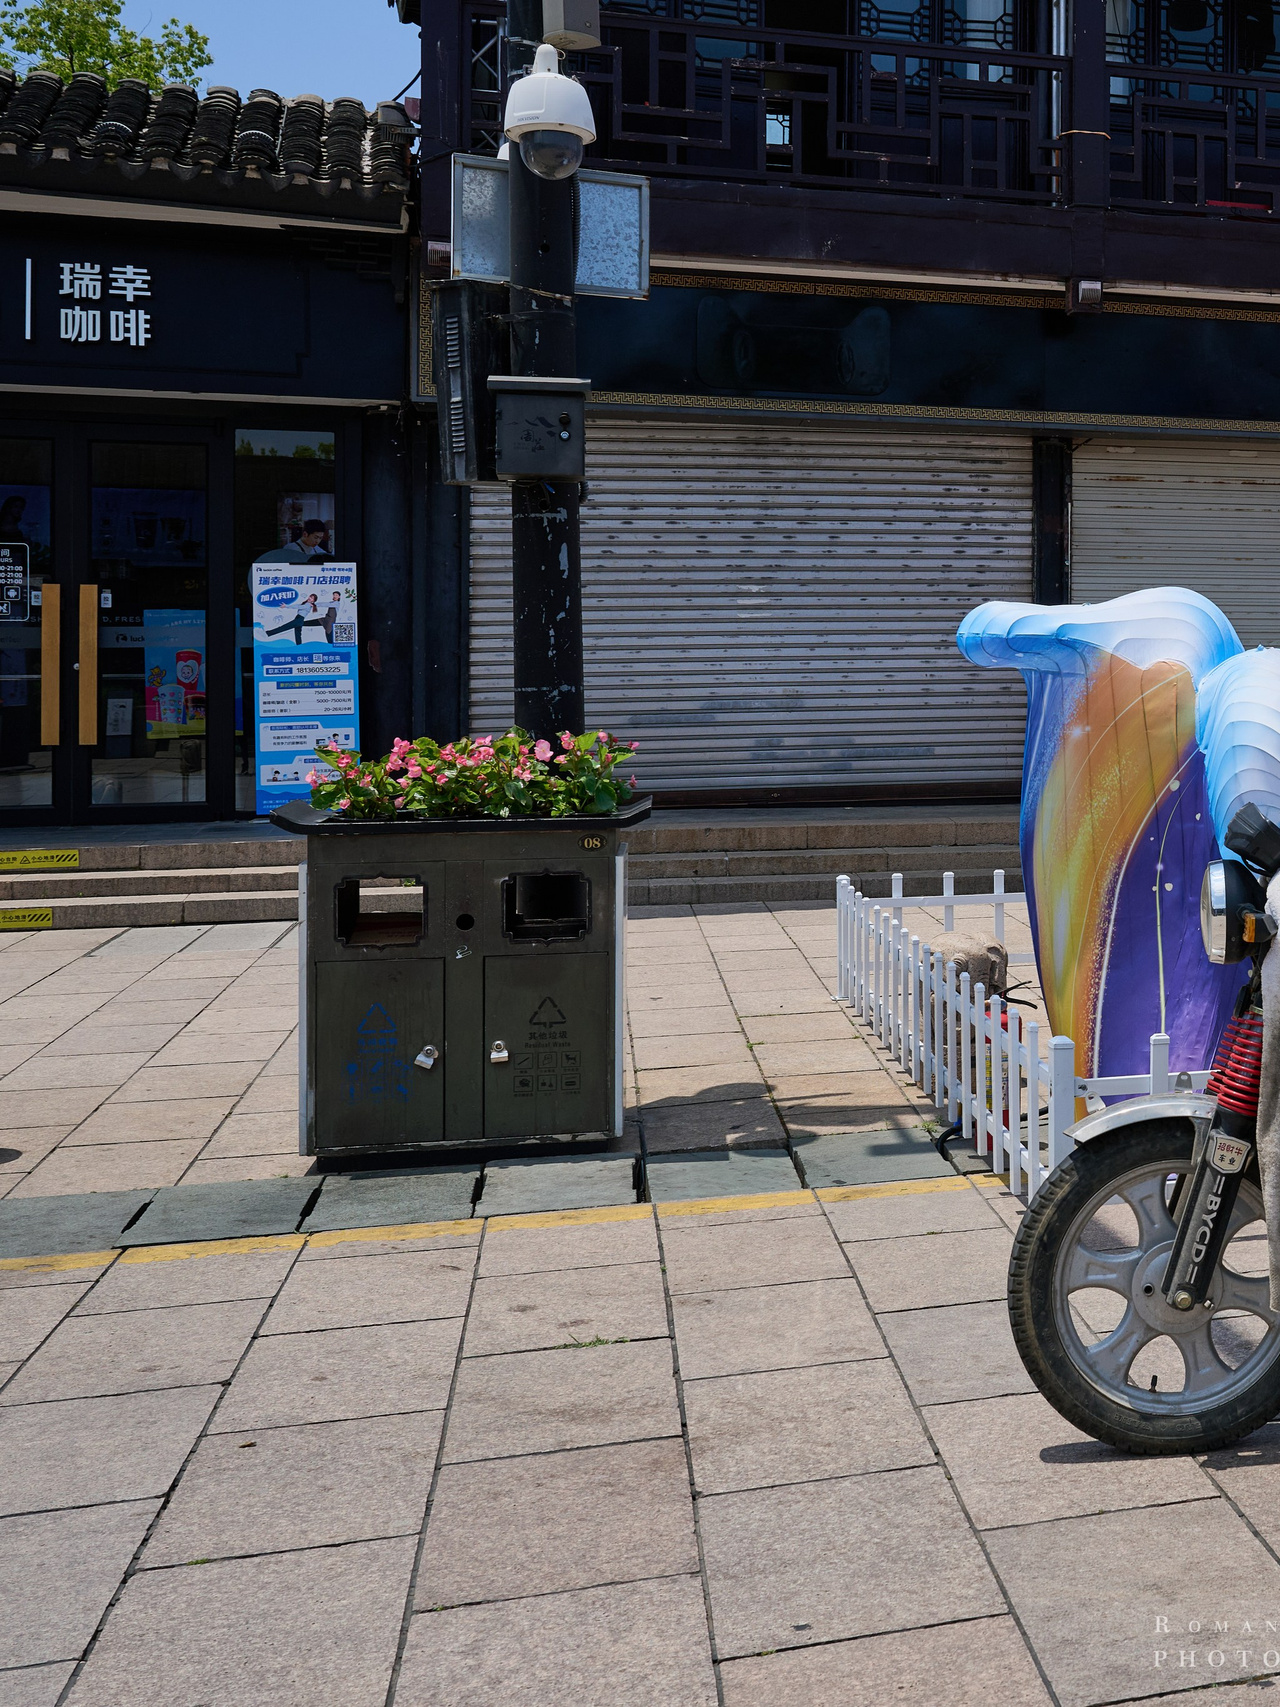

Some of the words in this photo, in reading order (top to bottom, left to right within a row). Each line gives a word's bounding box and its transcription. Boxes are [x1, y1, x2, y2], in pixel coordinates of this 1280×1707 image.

[58, 262, 151, 302] 瑞幸
[59, 305, 151, 346] 咖啡
[260, 590, 296, 602] 加入我们
[584, 837, 601, 849] 08
[528, 1031, 568, 1040] 其他垃圾
[1217, 1142, 1243, 1156] 招财牛
[1218, 1154, 1236, 1166] 车业
